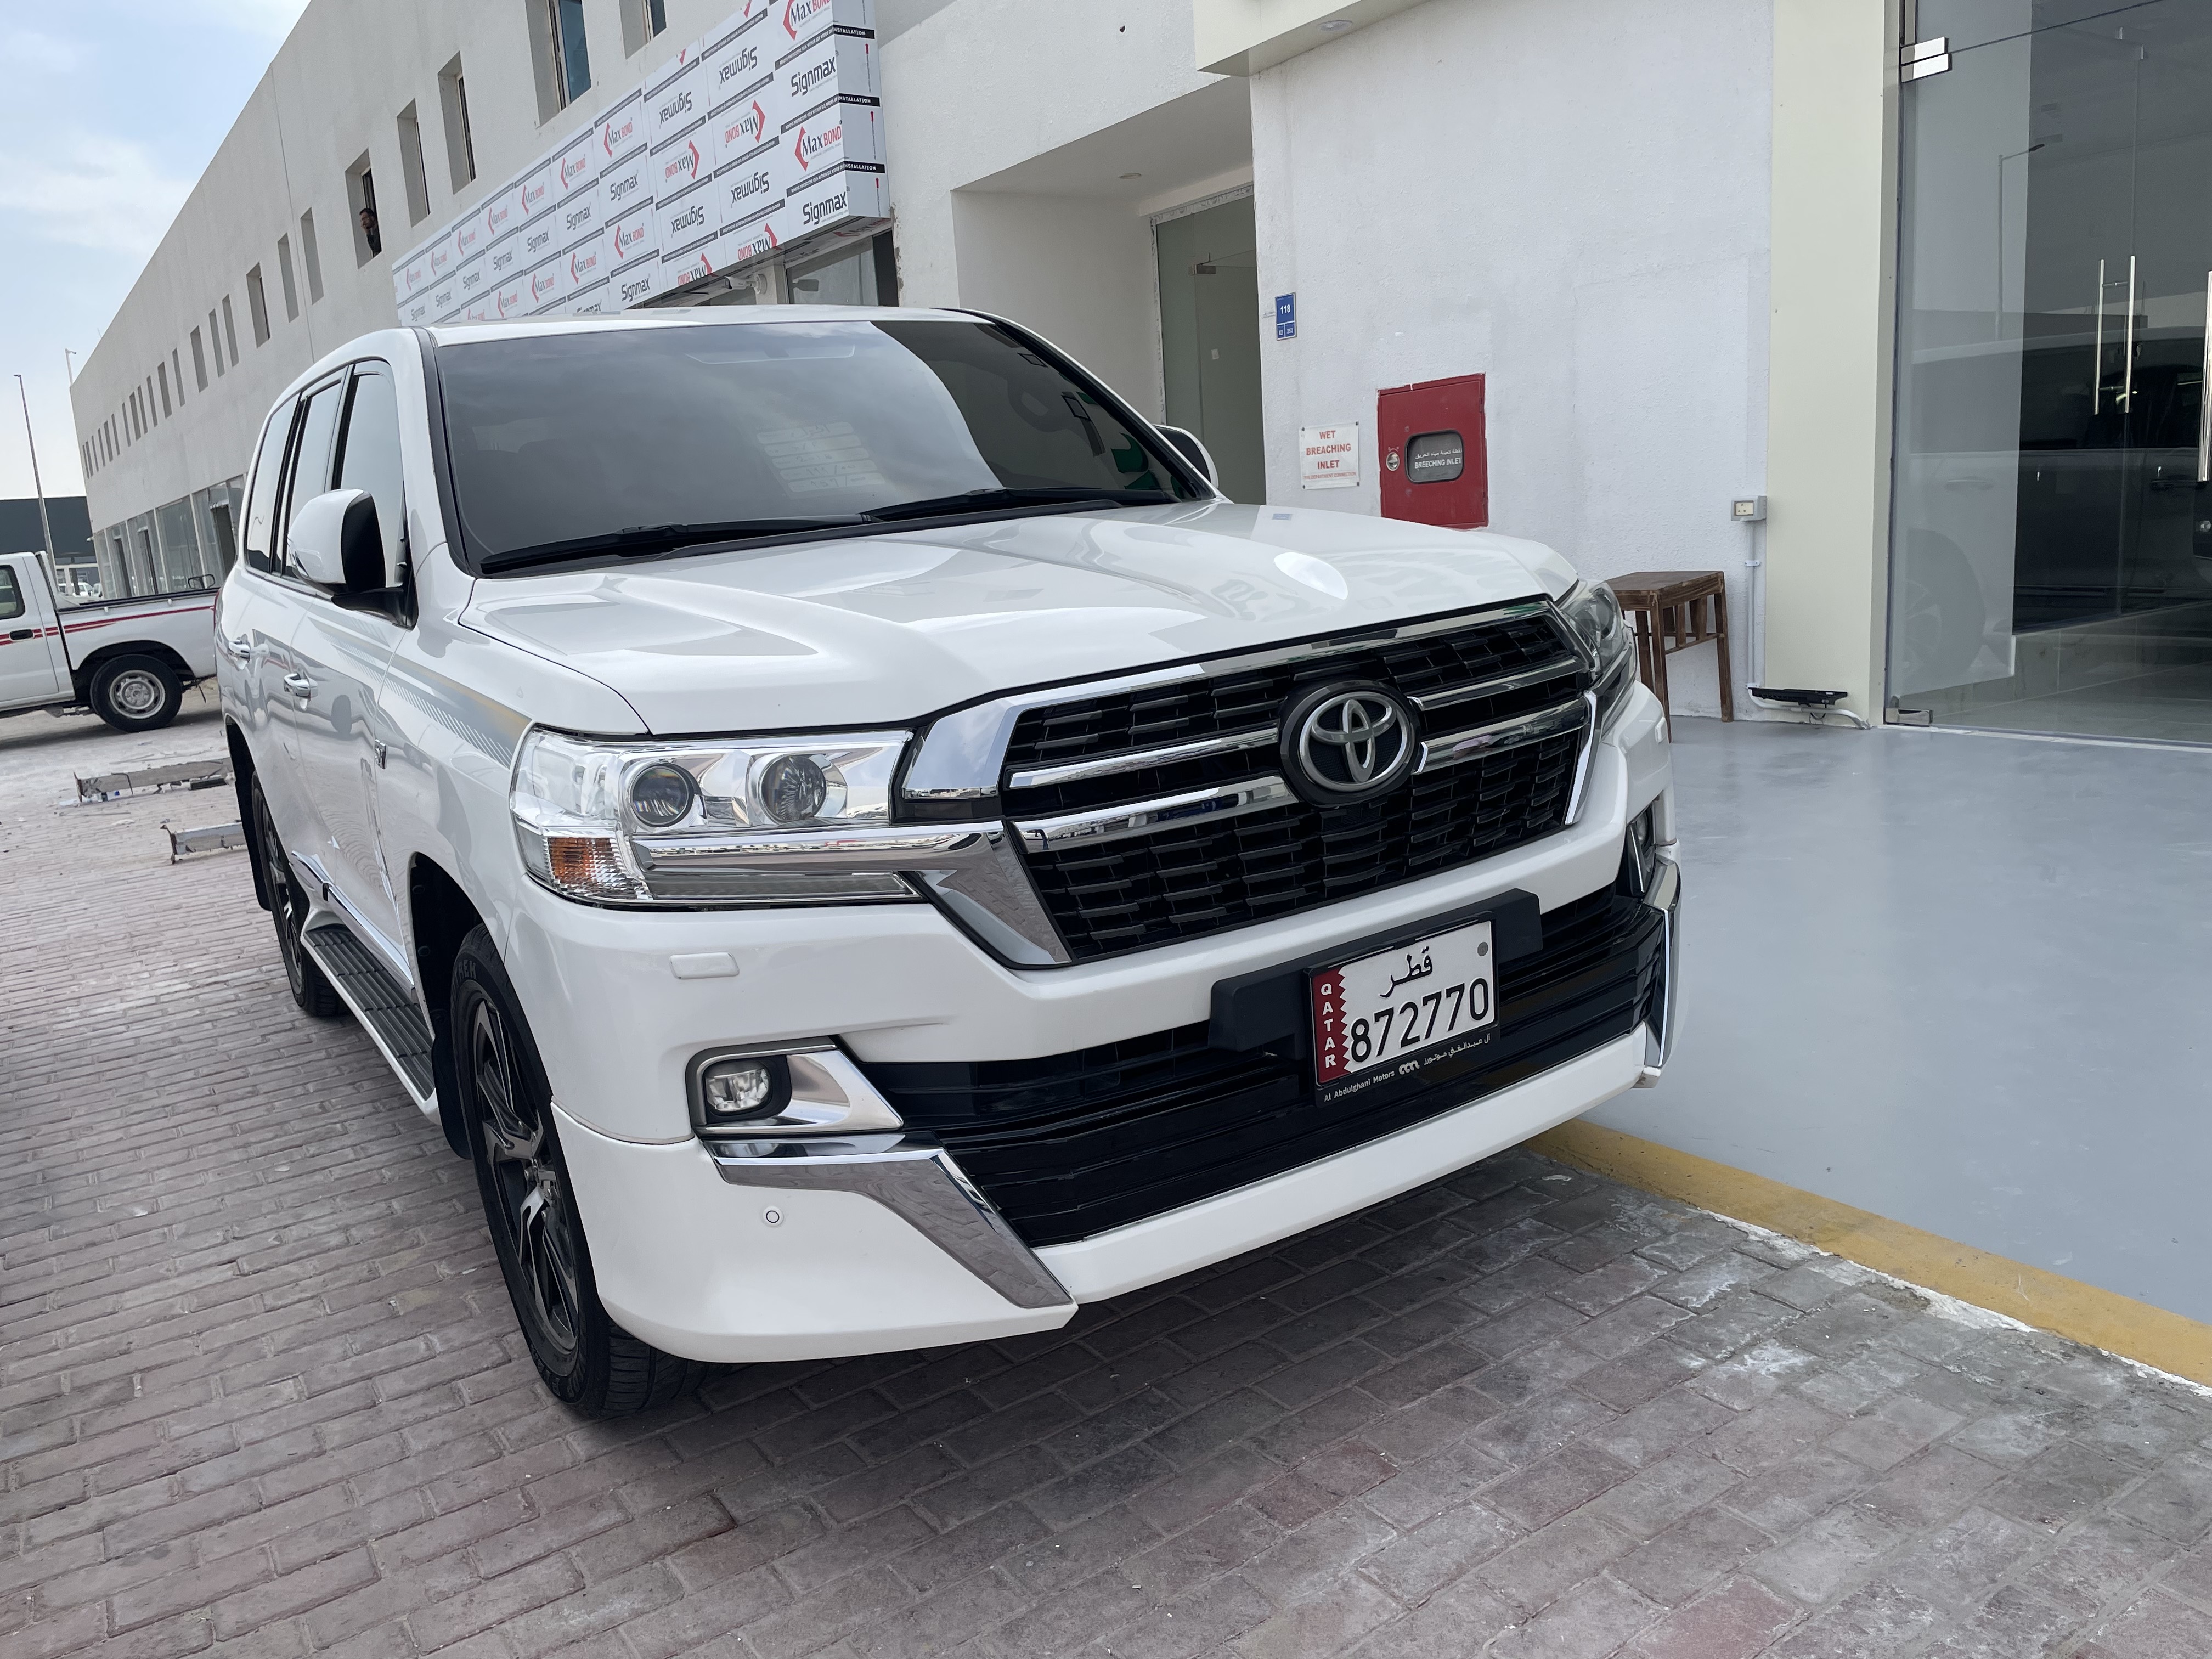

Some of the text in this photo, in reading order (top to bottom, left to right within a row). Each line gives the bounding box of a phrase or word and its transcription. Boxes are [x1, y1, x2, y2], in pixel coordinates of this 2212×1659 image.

[719, 46, 758, 84] Signmax
[791, 56, 836, 97] Signmax
[659, 91, 692, 125] Signmax
[610, 173, 639, 201] Signmax
[731, 171, 769, 204] Signmax
[566, 206, 591, 230] Signmax
[671, 205, 704, 234] Signmax
[803, 191, 847, 225] Signmax
[621, 277, 650, 302] Signmax
[1280, 304, 1291, 314] 118
[1306, 443, 1351, 455] BREACHING
[1319, 430, 1336, 439] WET
[1317, 460, 1340, 469] INLET
[1414, 459, 1445, 469] BREECHING
[1379, 946, 1433, 998] قطر
[1321, 983, 1336, 1068] QATAR
[1351, 978, 1488, 1063] 872770
[1324, 1070, 1395, 1102] Al Abdulghani Motors
